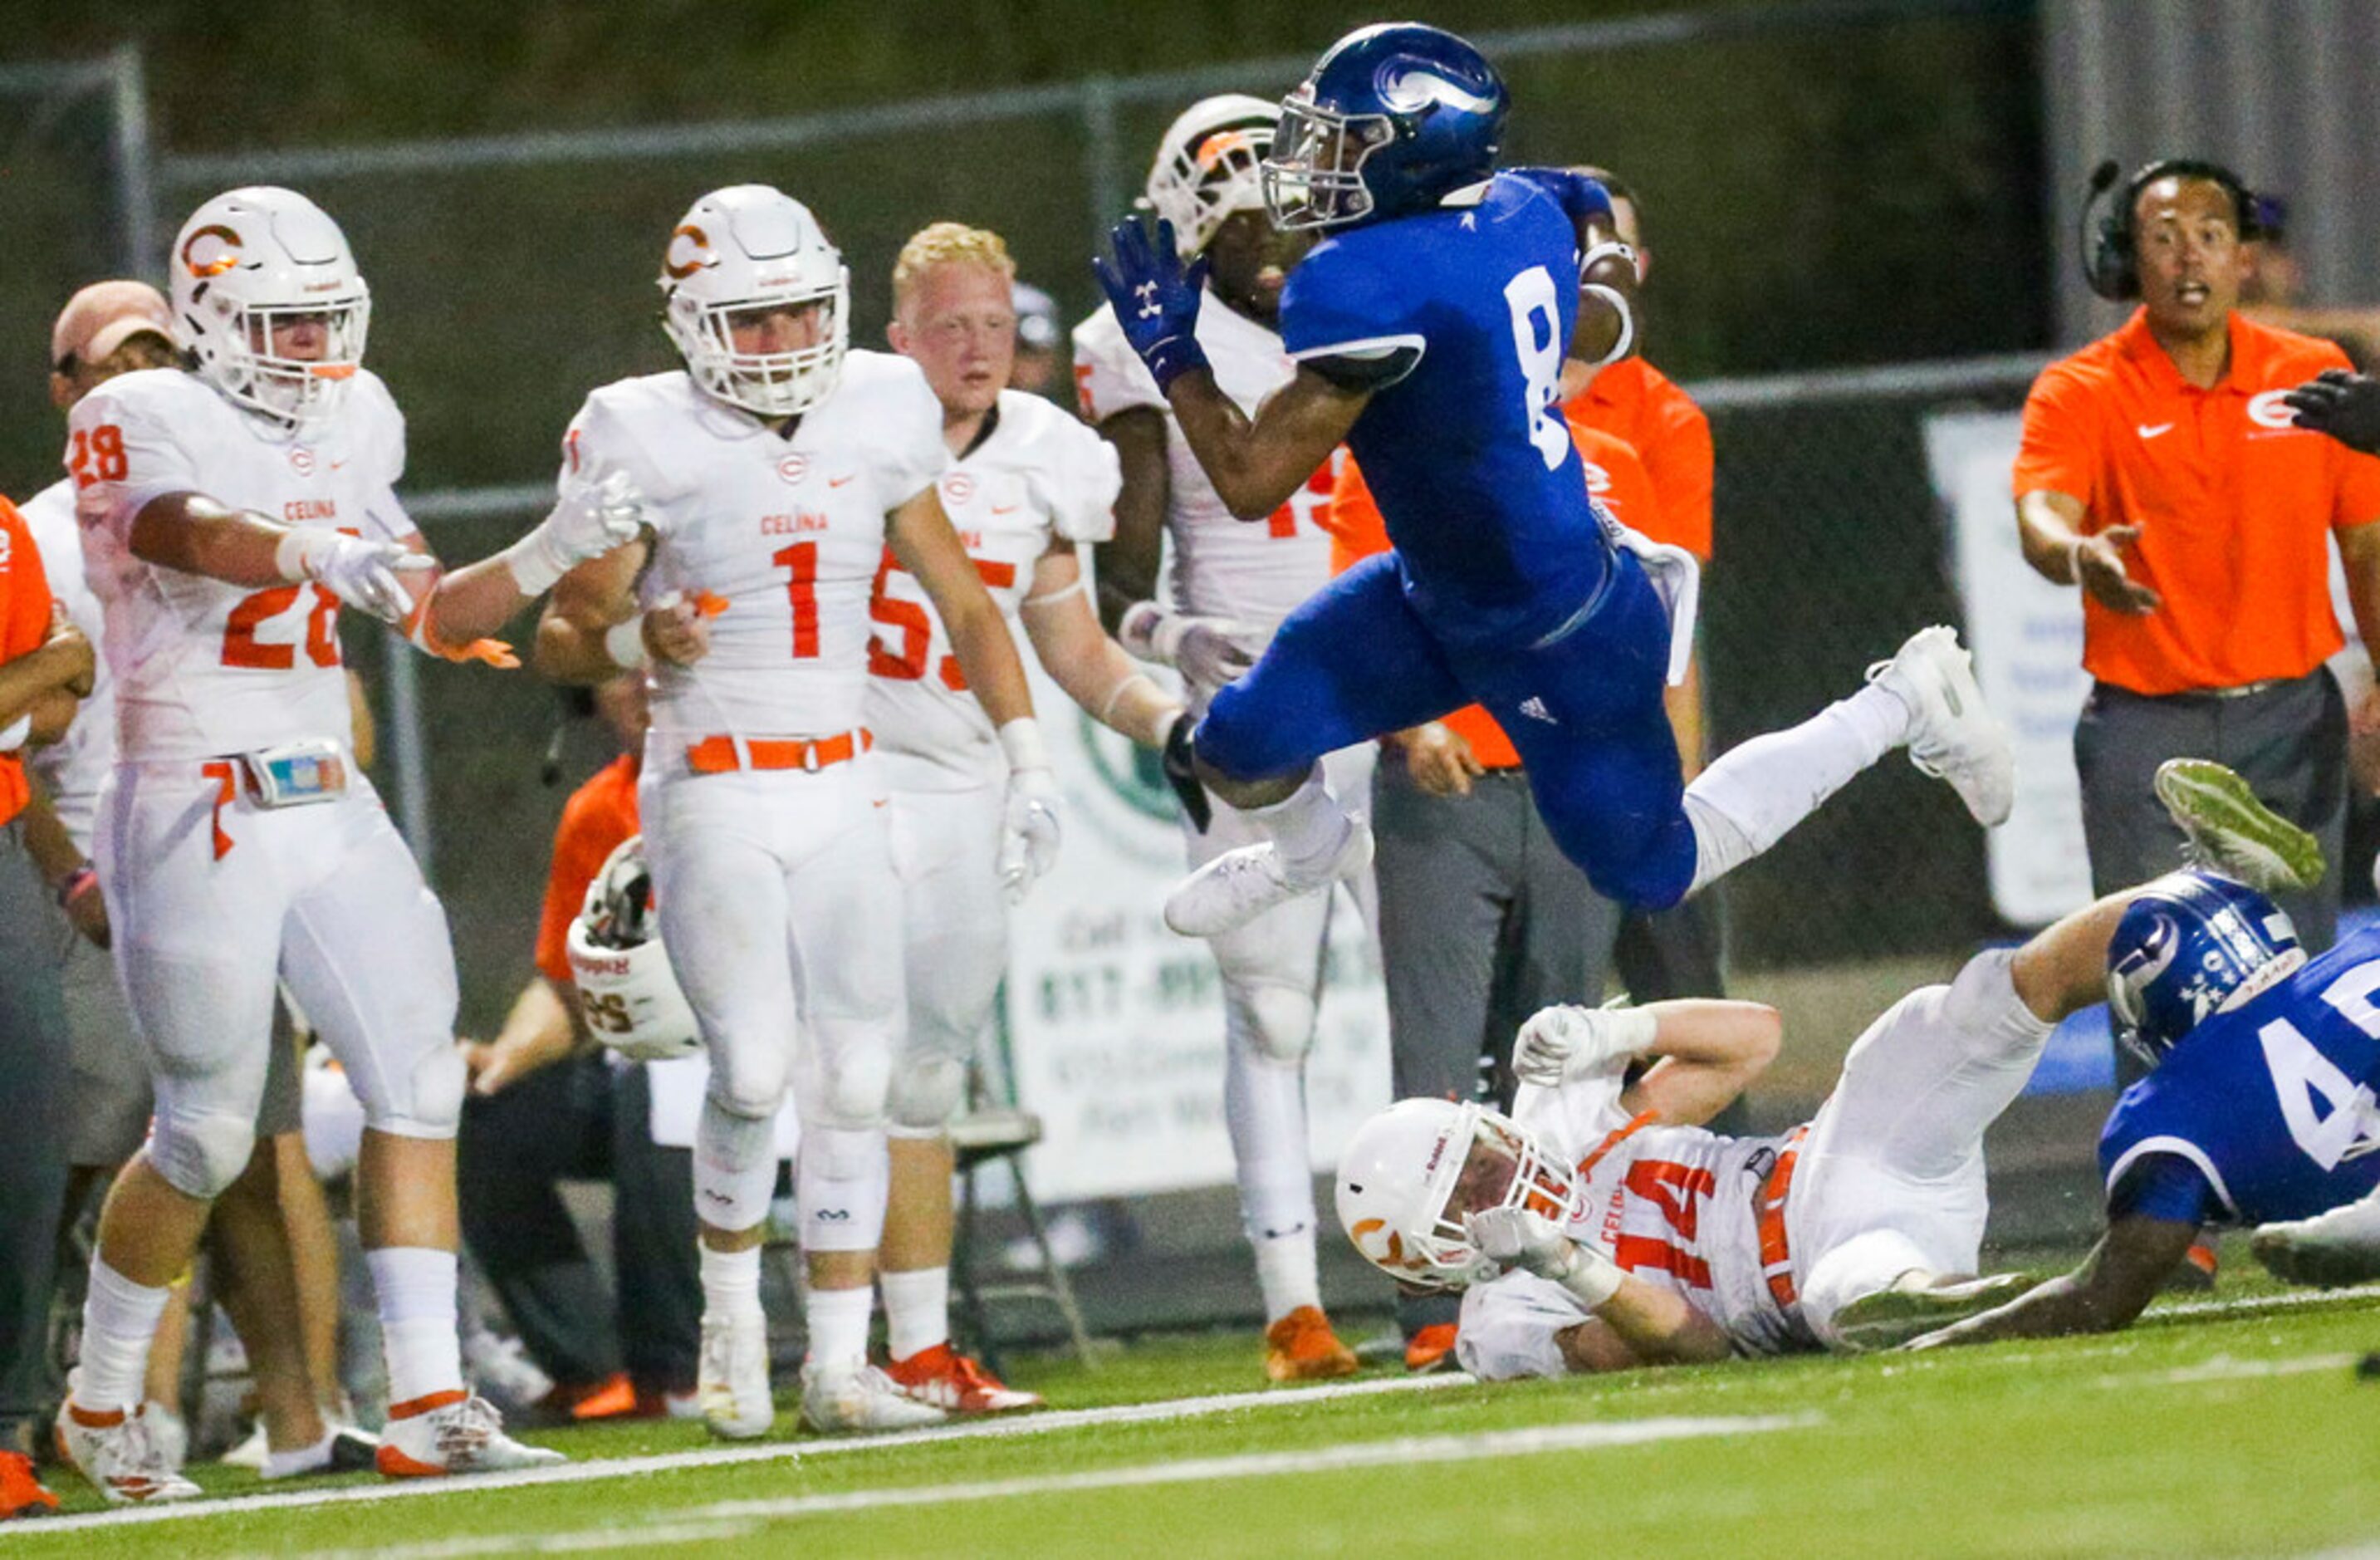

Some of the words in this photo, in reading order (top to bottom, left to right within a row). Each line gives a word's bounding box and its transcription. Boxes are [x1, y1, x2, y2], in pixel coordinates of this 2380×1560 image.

[1503, 266, 1570, 472] 8
[284, 499, 336, 522] CELINA
[761, 513, 828, 536] CELINA
[772, 541, 819, 658] 1
[1615, 1159, 1716, 1291] 14
